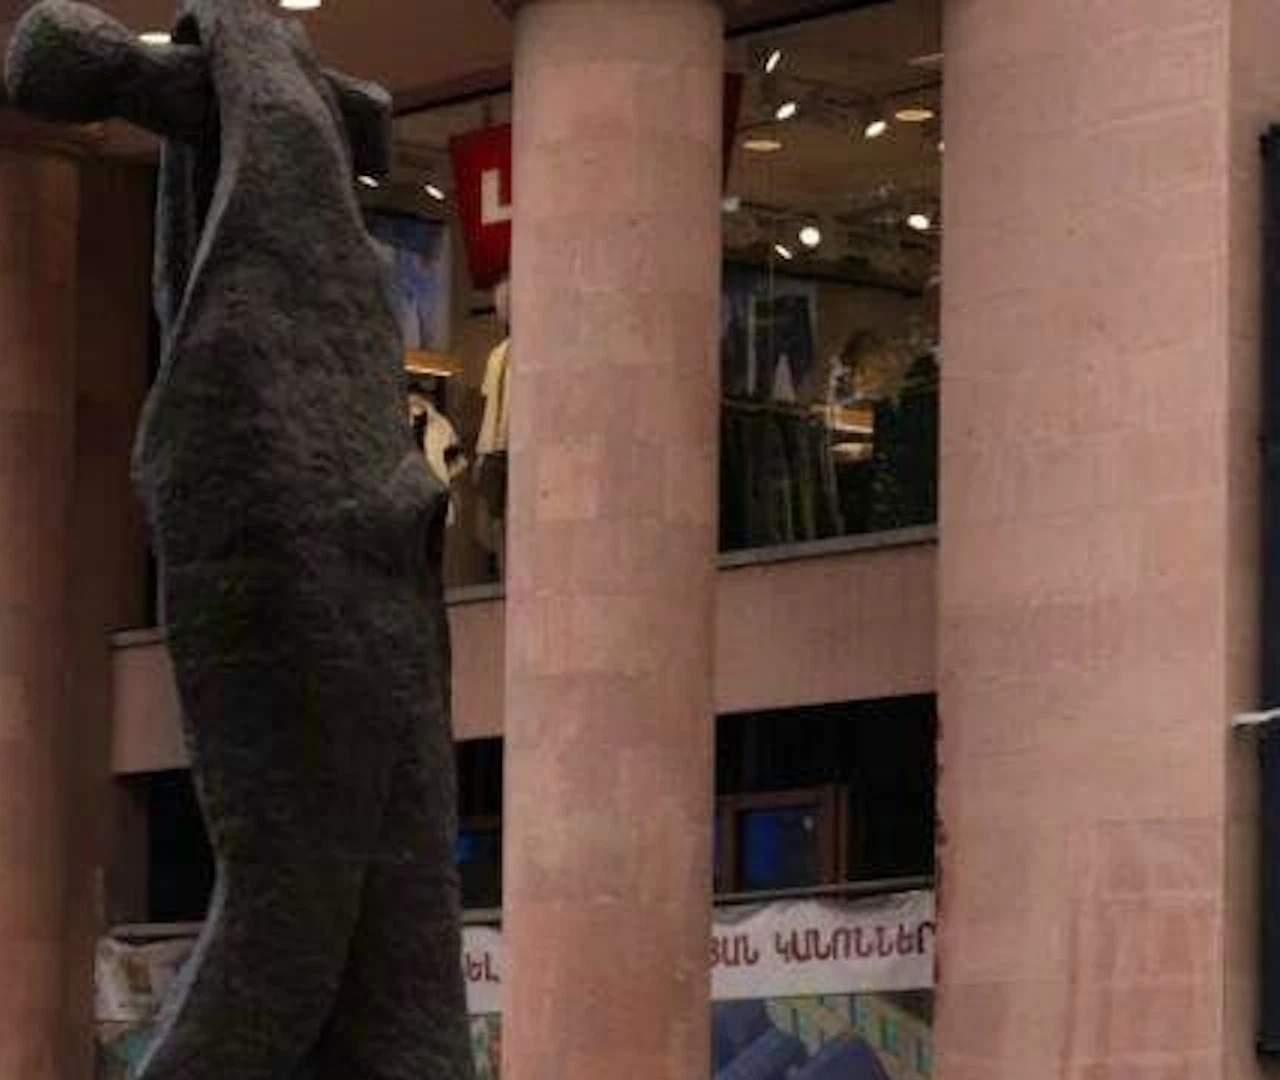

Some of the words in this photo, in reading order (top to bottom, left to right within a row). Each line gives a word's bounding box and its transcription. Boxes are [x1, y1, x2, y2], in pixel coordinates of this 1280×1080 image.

[466, 951, 502, 983] ԵԼ
[706, 933, 760, 967] ՅԱՆ
[775, 921, 937, 963] ԿԱՆՈՆՆԵՐ
